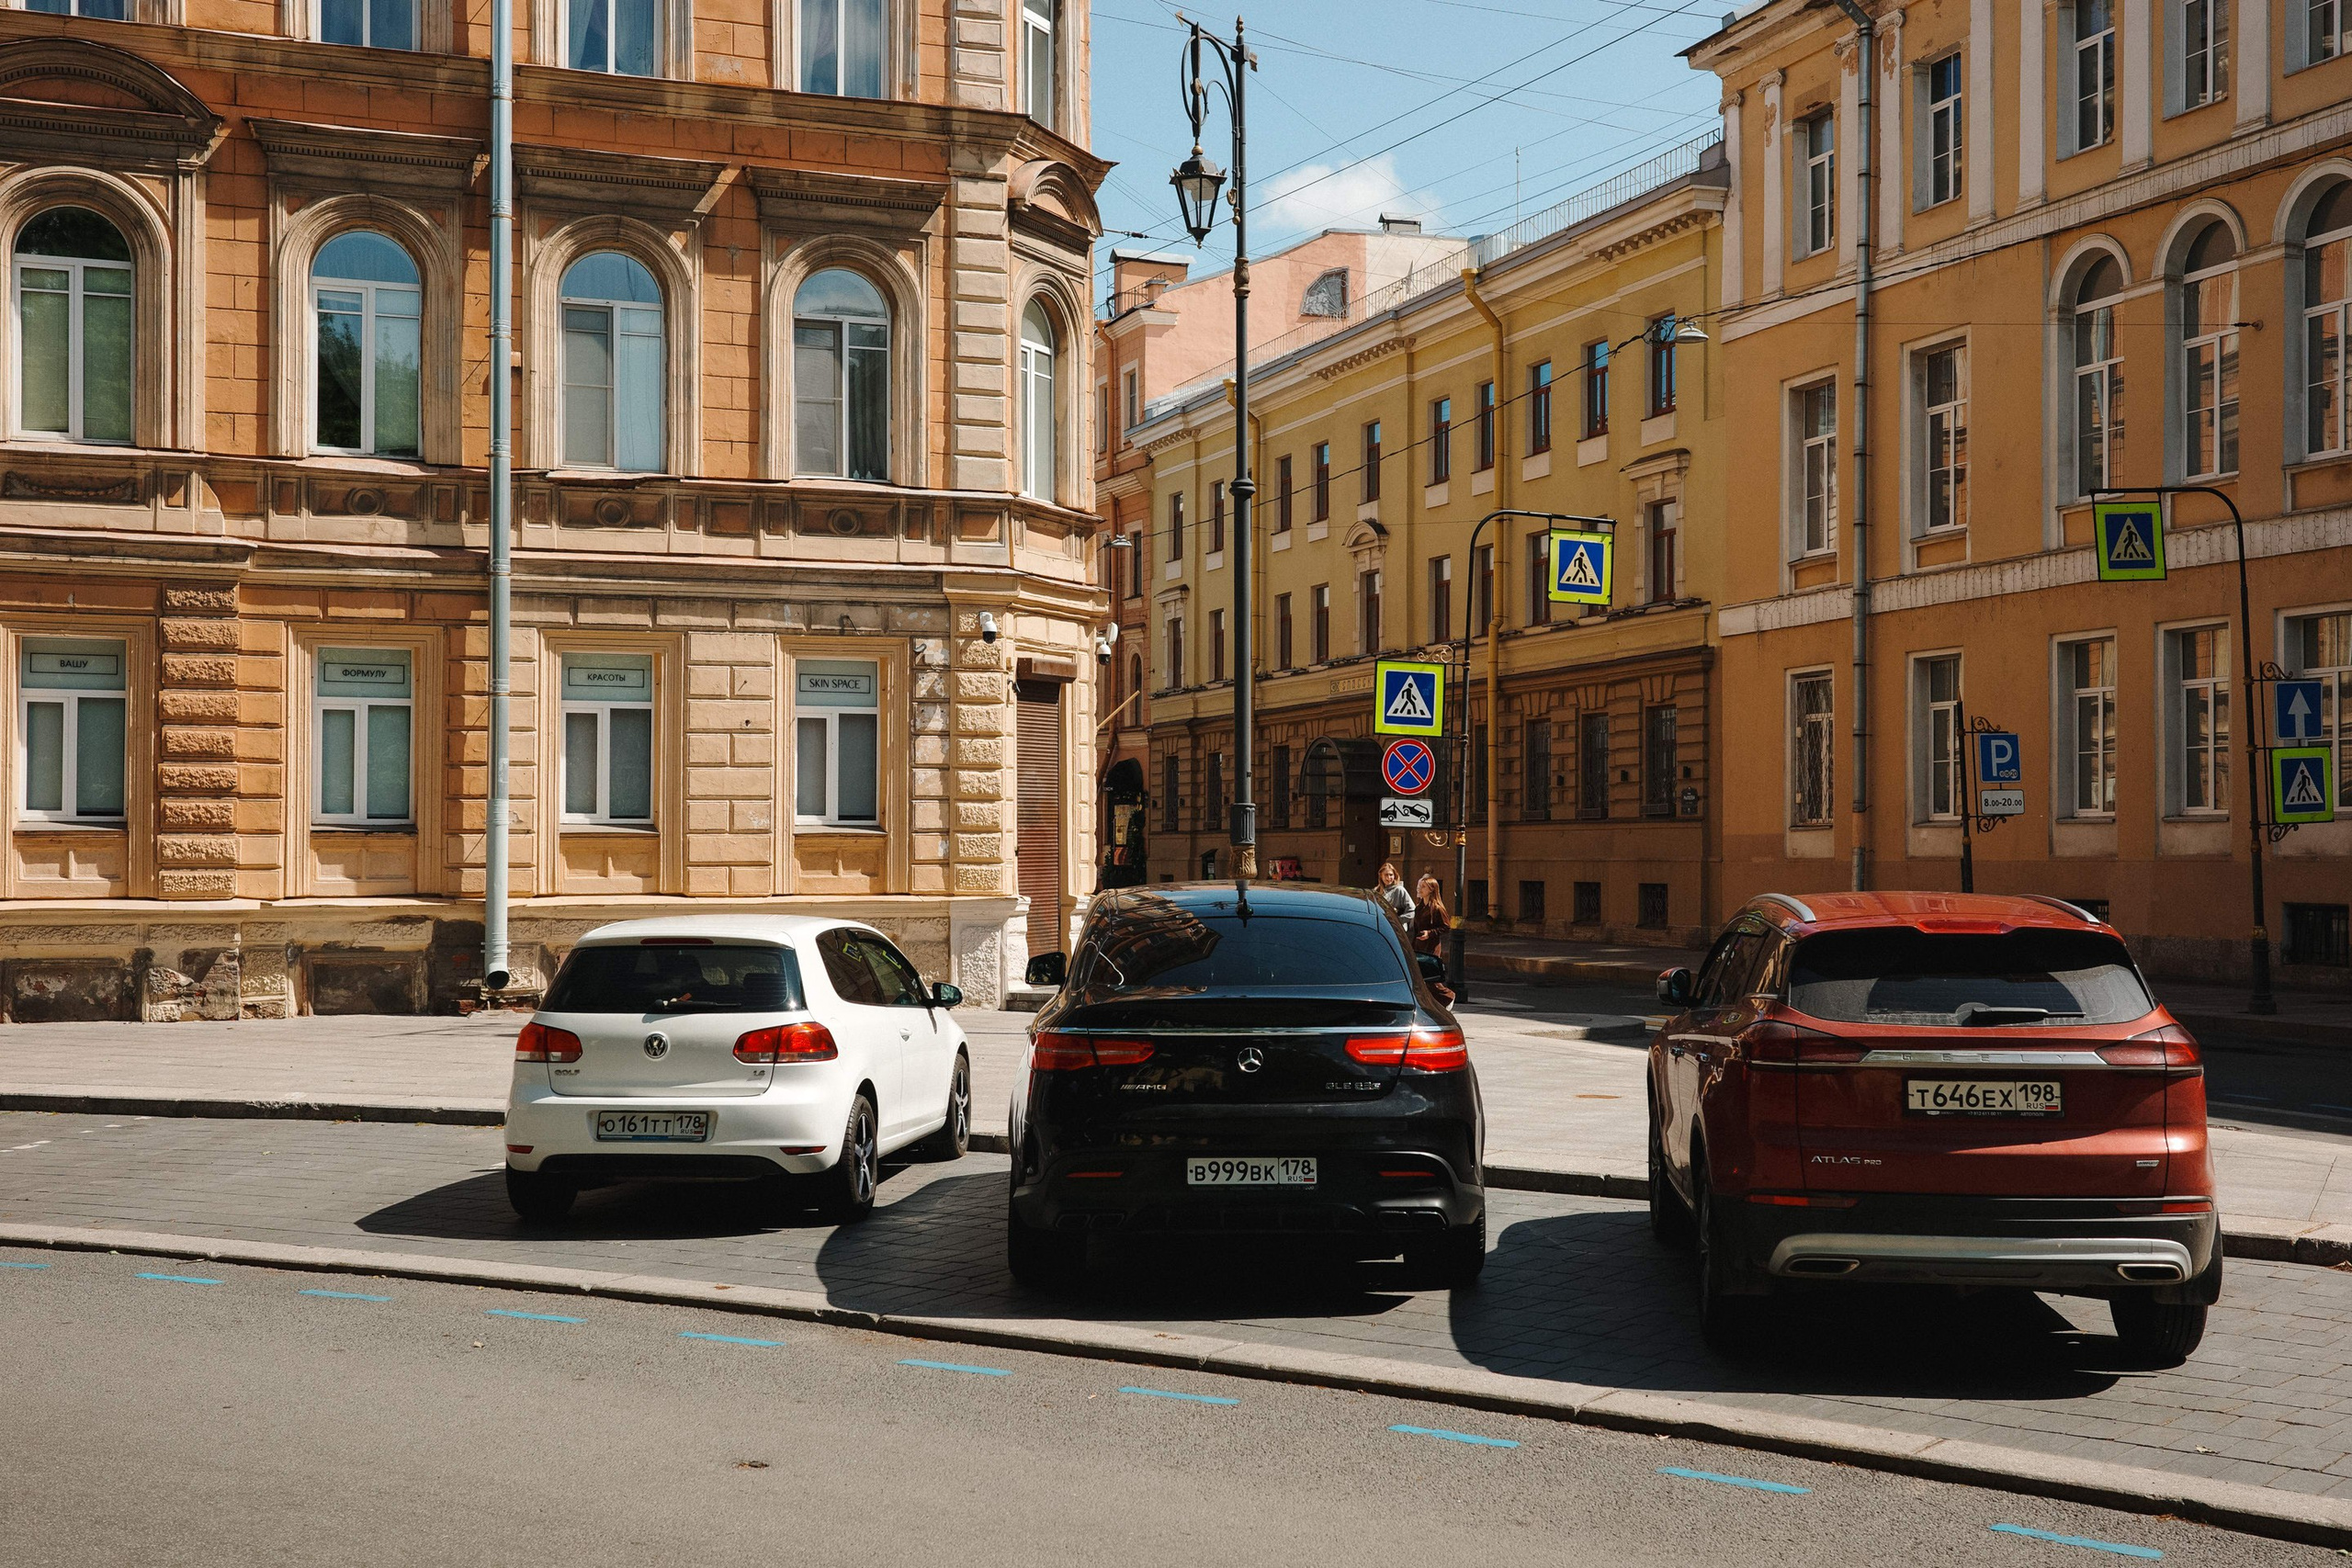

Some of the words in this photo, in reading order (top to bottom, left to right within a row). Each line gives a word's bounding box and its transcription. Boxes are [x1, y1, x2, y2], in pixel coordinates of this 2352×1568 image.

[60, 660, 89, 669] ВАШУ
[342, 669, 387, 678] ФОРМУЛУ
[587, 673, 626, 682] КРАСОТЫ
[808, 678, 830, 688] SKIN
[831, 679, 861, 689] SPACE
[1990, 739, 2013, 777] P
[1901, 1053, 2066, 1063] GEELY
[554, 1068, 581, 1077] GOLF
[2018, 1083, 2055, 1102] 198
[1811, 1155, 1861, 1165] ATLAS
[1281, 1159, 1311, 1176] 178
